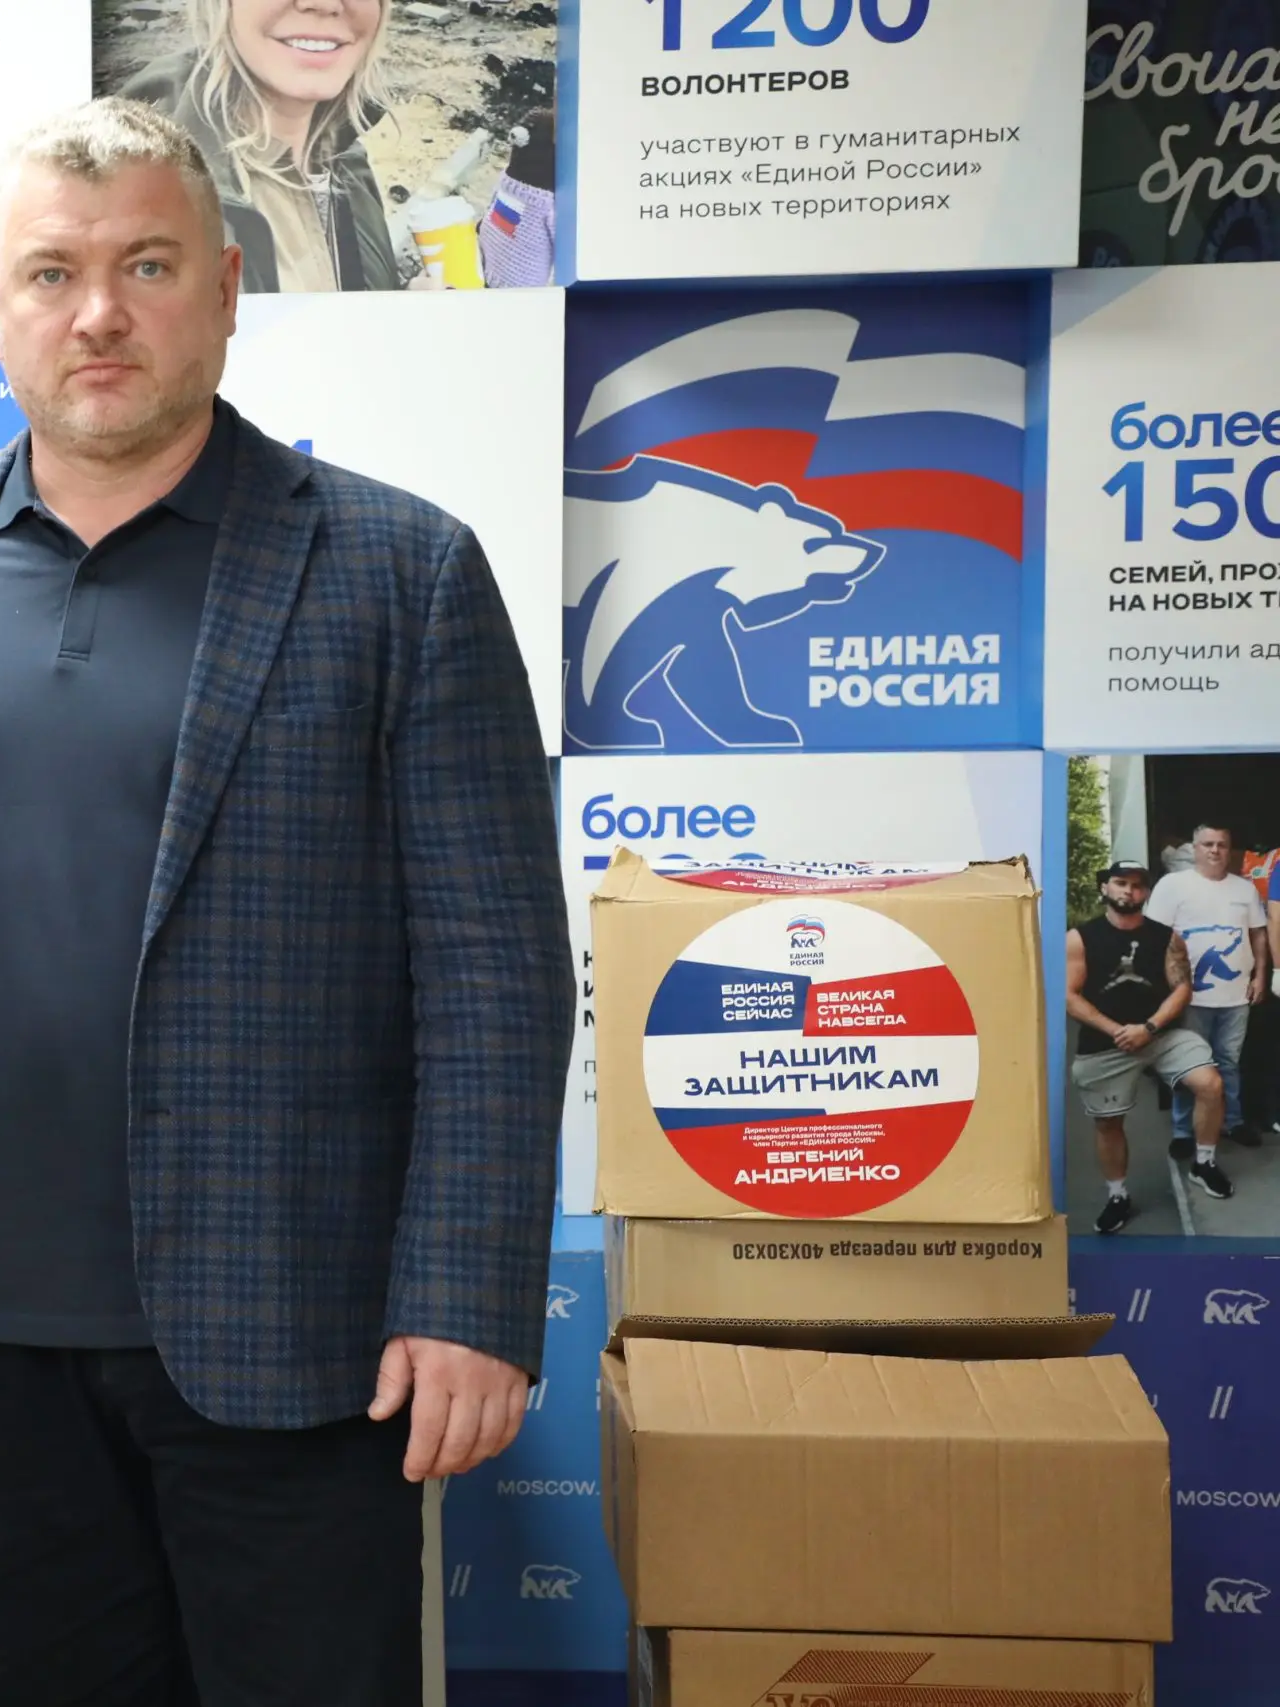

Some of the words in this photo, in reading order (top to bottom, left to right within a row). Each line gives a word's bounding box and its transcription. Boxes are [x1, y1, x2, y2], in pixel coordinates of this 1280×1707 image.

[643, 0, 931, 51] 1200
[642, 69, 849, 96] ВОЛОНТЕРОВ
[641, 136, 785, 160] участвуют
[796, 135, 809, 149] в
[820, 126, 1020, 154] гуманитарных
[639, 170, 732, 188] акциях
[640, 204, 669, 219] на
[680, 201, 761, 218] новых
[772, 194, 950, 219] территориях
[1109, 560, 1213, 584] СЕМЕЙ,
[1109, 595, 1146, 612] НА
[1153, 592, 1252, 611] НОВЫХ
[809, 634, 999, 671] ЕДИНАЯ
[1109, 644, 1240, 665] получили
[809, 673, 999, 707] РОССИЯ
[1109, 676, 1219, 692] помощь
[582, 793, 756, 840] более
[721, 981, 793, 995] ЕДИНАЯ
[817, 990, 894, 1003] ВЕЛИКАЯ
[722, 995, 795, 1008] РОССИЯ
[817, 1003, 884, 1015] СТРАНА
[723, 1008, 793, 1021] СЕЙЧАС
[818, 1014, 906, 1027] НАВСЕГДА
[740, 1045, 876, 1069] НАШИМ
[684, 1068, 939, 1096] ЗАЩИТНИКАМ
[767, 1147, 863, 1164] ЕВГЕНИЙ
[734, 1165, 900, 1184] АНДРИЕНКО
[830, 1240, 917, 1256] переезда
[923, 1240, 956, 1256] для
[963, 1242, 1042, 1260] Коробка
